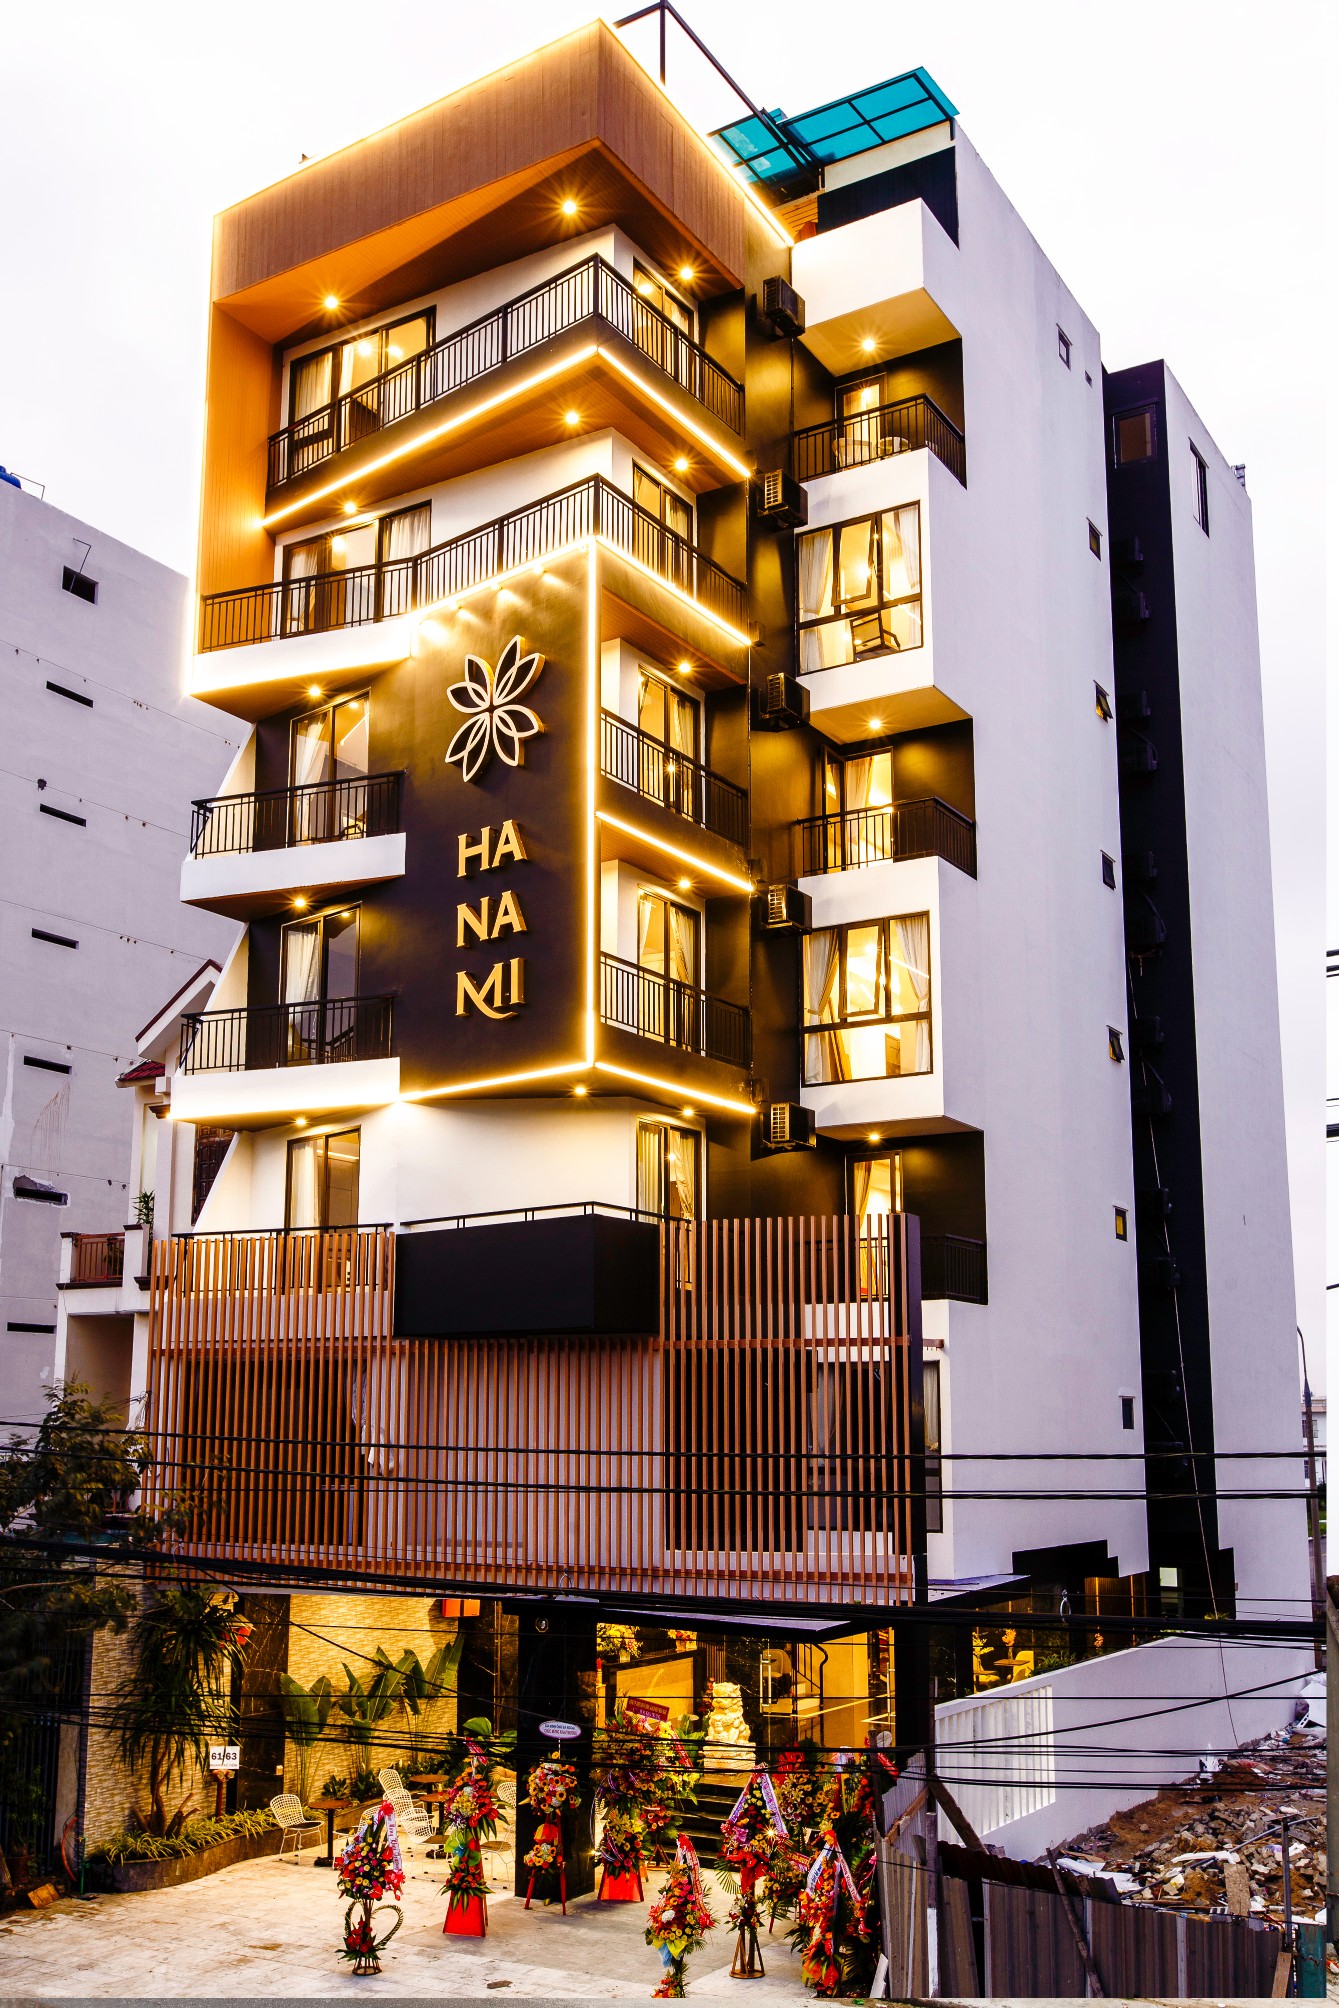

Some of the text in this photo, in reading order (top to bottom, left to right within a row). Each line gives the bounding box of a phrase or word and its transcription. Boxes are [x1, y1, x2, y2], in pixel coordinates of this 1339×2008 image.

[457, 819, 528, 878] HA
[457, 890, 527, 948] NA
[456, 957, 525, 1020] MI
